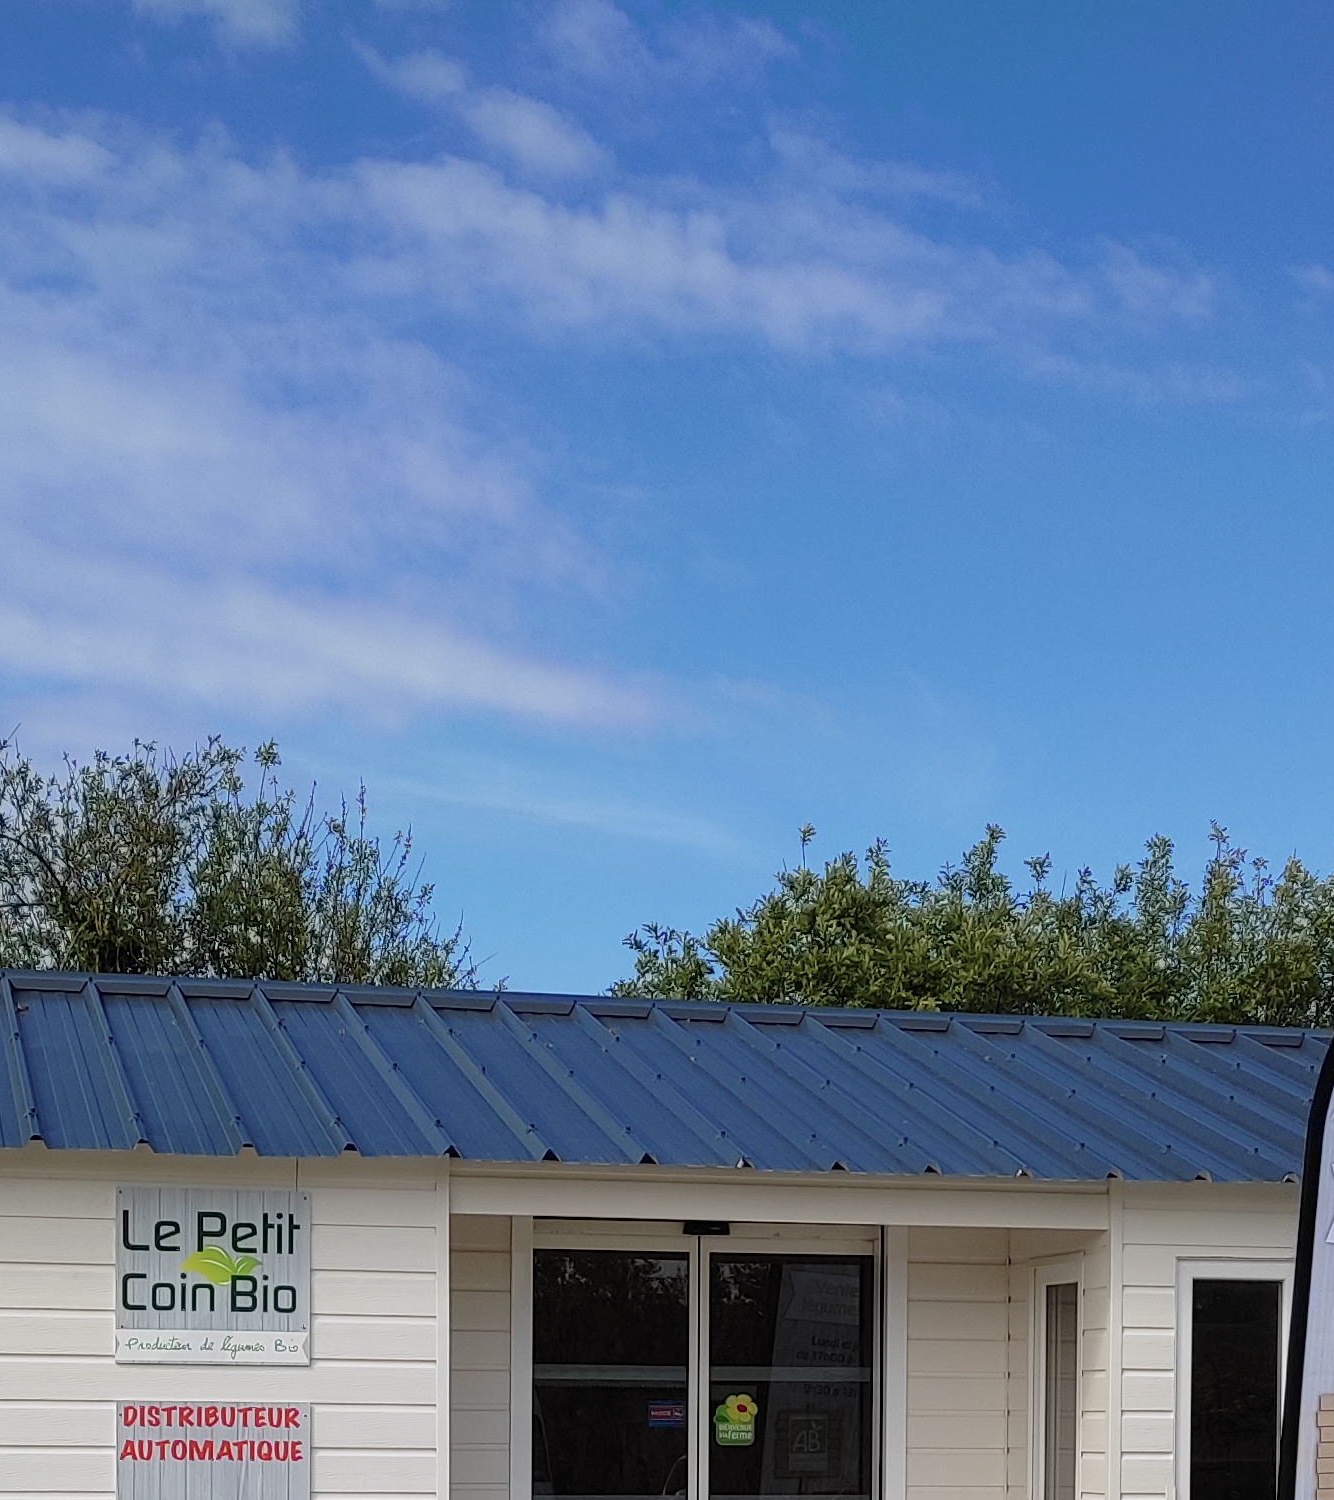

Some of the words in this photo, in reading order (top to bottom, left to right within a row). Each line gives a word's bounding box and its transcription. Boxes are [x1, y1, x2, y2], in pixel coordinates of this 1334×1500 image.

[122, 1209, 181, 1252] Le
[197, 1211, 301, 1254] Petit
[122, 1272, 215, 1311] Coin
[230, 1274, 297, 1313] Bio
[124, 1336, 193, 1352] Producteur
[200, 1337, 214, 1351] de
[220, 1335, 265, 1359] légumes
[274, 1338, 299, 1352] Bio
[123, 1405, 301, 1429] DISTRIBUTEUR
[728, 1430, 753, 1440] ferme
[120, 1439, 303, 1461] AUTOMATIQUE
